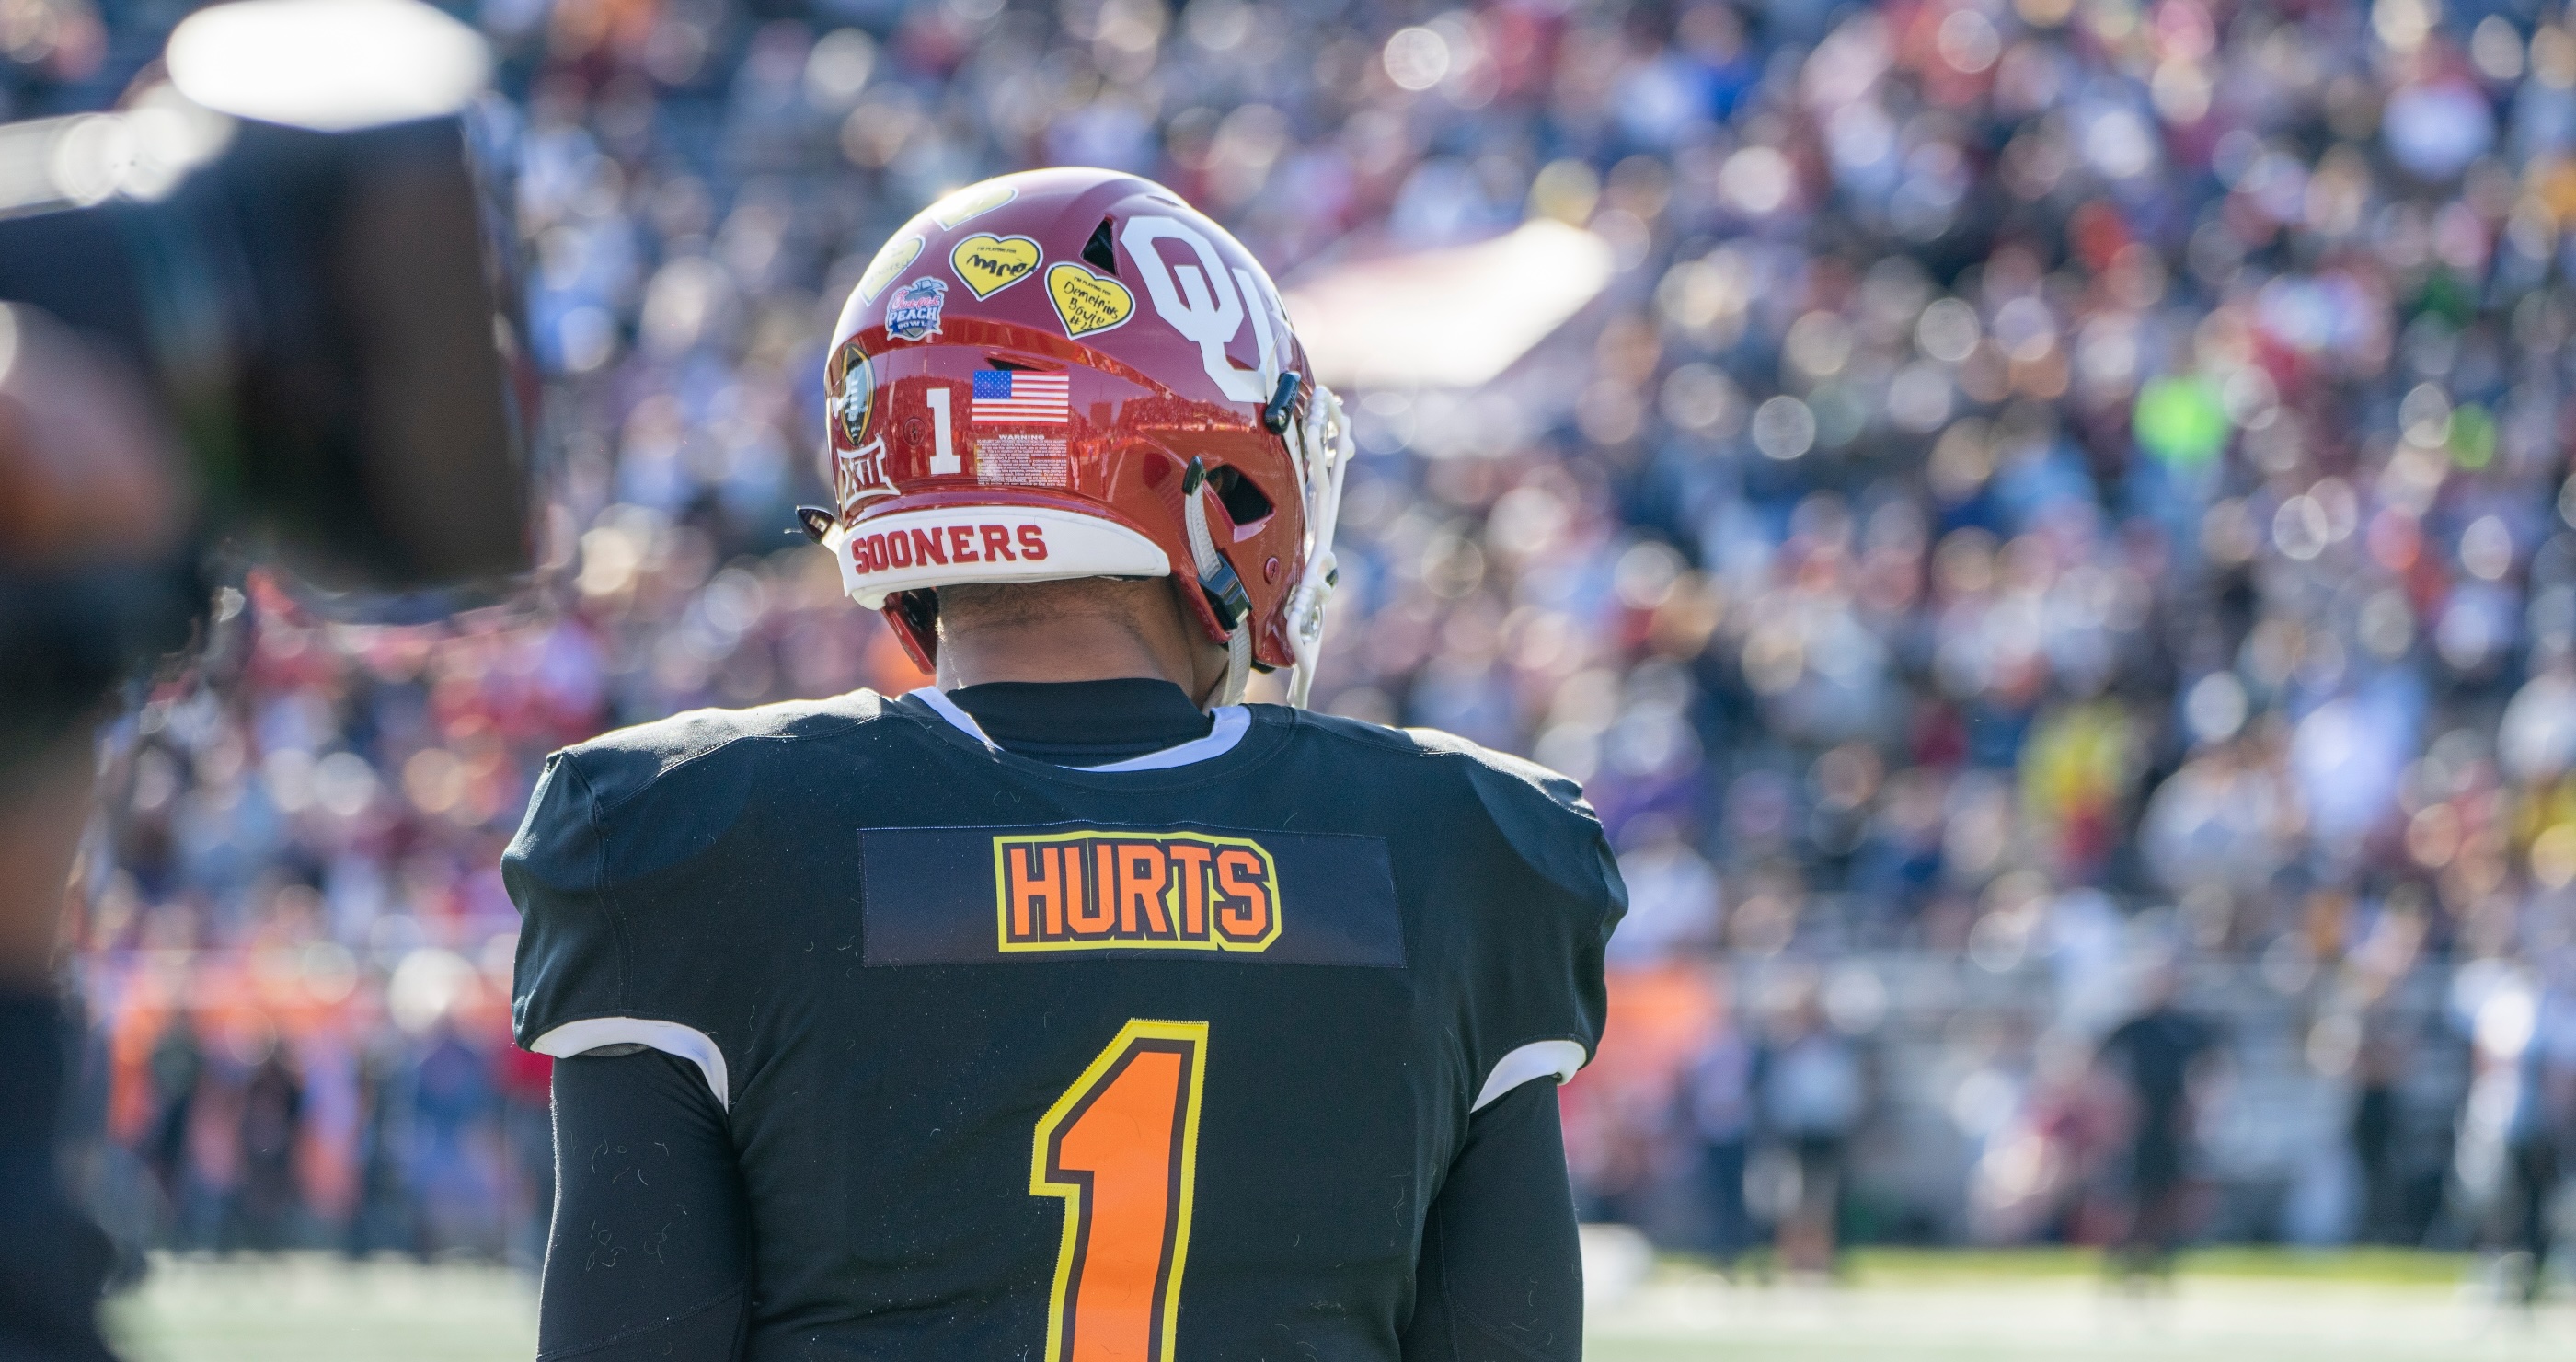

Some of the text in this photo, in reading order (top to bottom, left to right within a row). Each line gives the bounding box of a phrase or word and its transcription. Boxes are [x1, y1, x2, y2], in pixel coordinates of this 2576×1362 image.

[889, 306, 937, 327] PEACH
[897, 320, 926, 329] BOWL
[1120, 216, 1279, 403] OU
[926, 388, 961, 475] 1
[851, 524, 1048, 575] SOONERS
[995, 831, 1281, 952] HURTS
[1029, 1018, 1209, 1362] 1
